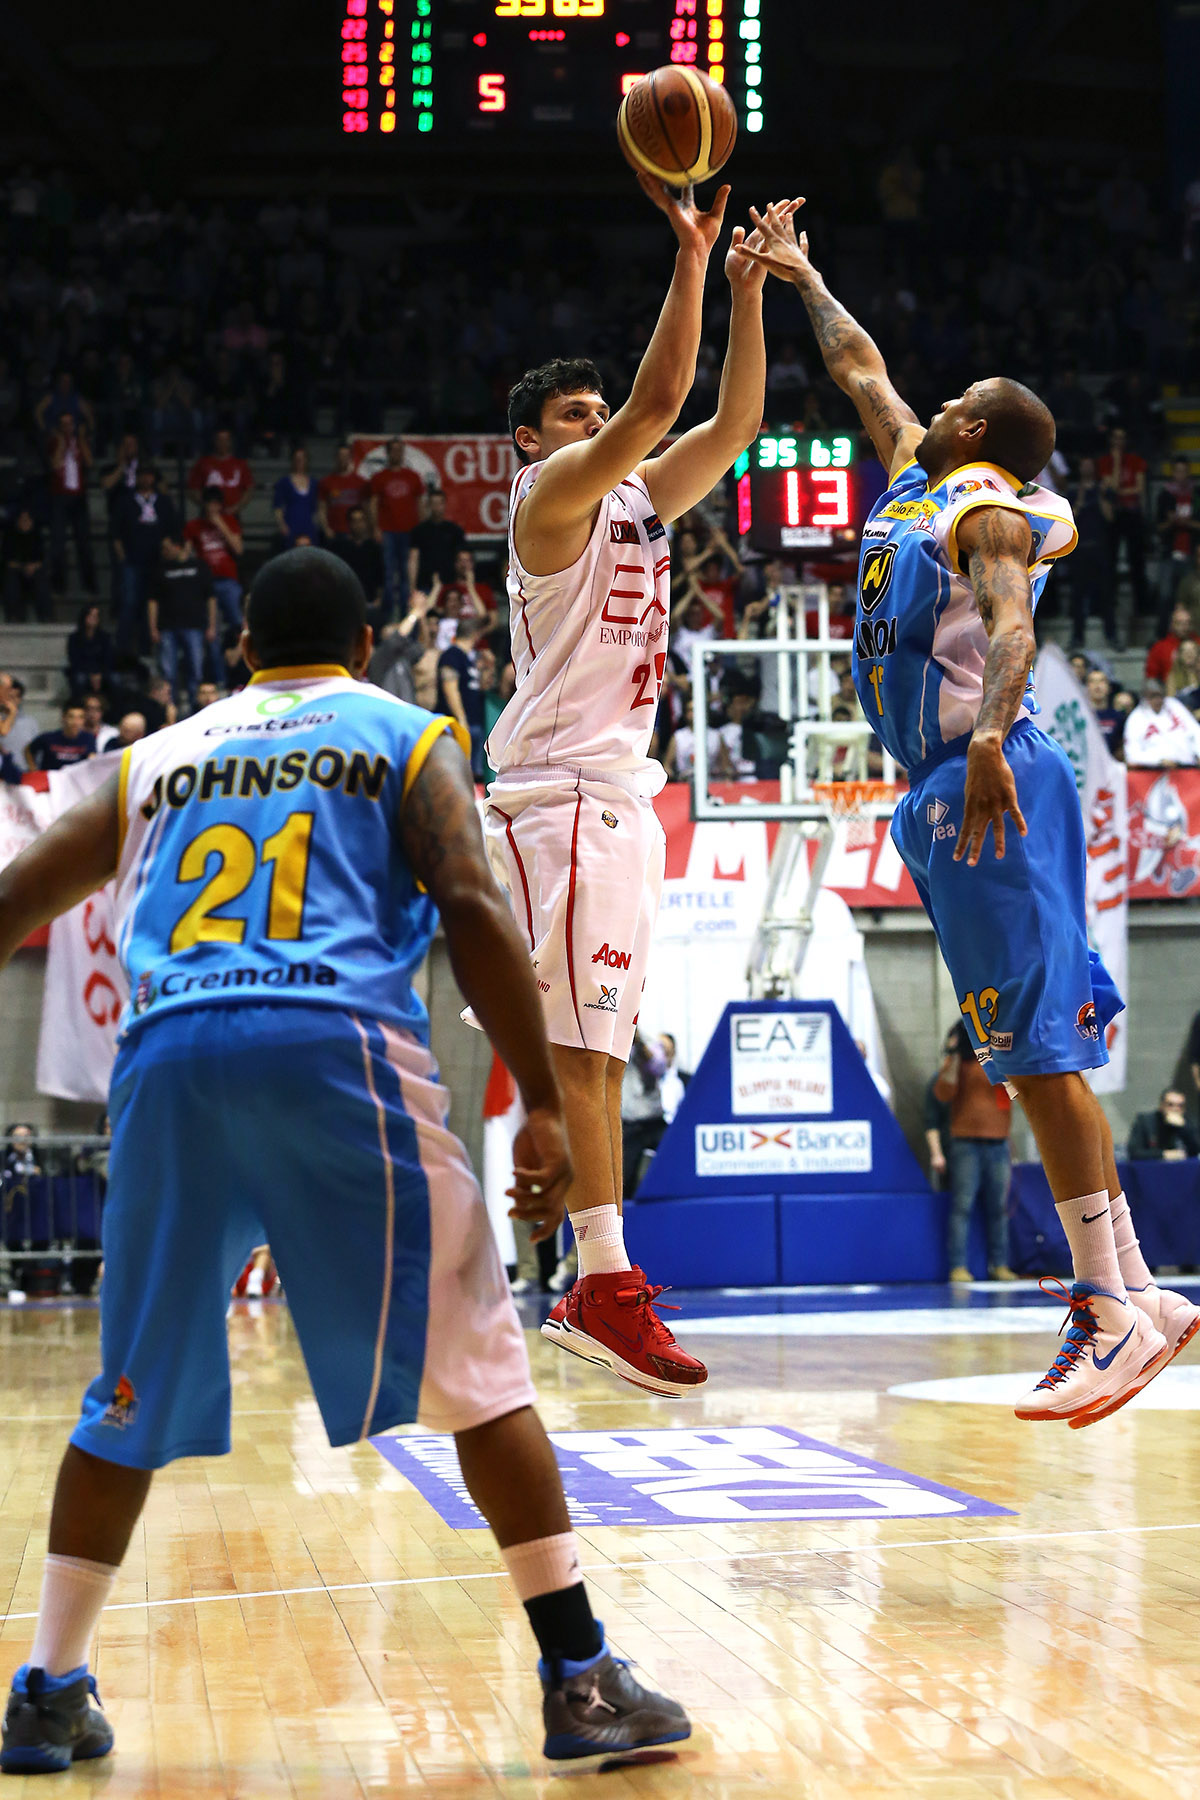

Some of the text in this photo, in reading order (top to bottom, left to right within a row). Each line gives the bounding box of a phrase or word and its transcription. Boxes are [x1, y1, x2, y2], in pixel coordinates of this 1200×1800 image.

[479, 74, 505, 112] 5
[759, 437, 851, 468] 35 63
[786, 470, 849, 526] 13
[140, 746, 390, 822] JOHNSON
[169, 812, 316, 956] 21
[161, 962, 337, 997] Cremona
[736, 1018, 824, 1053] EA7
[702, 1128, 867, 1153] UBI Banca
[547, 1426, 969, 1520] BEKO
